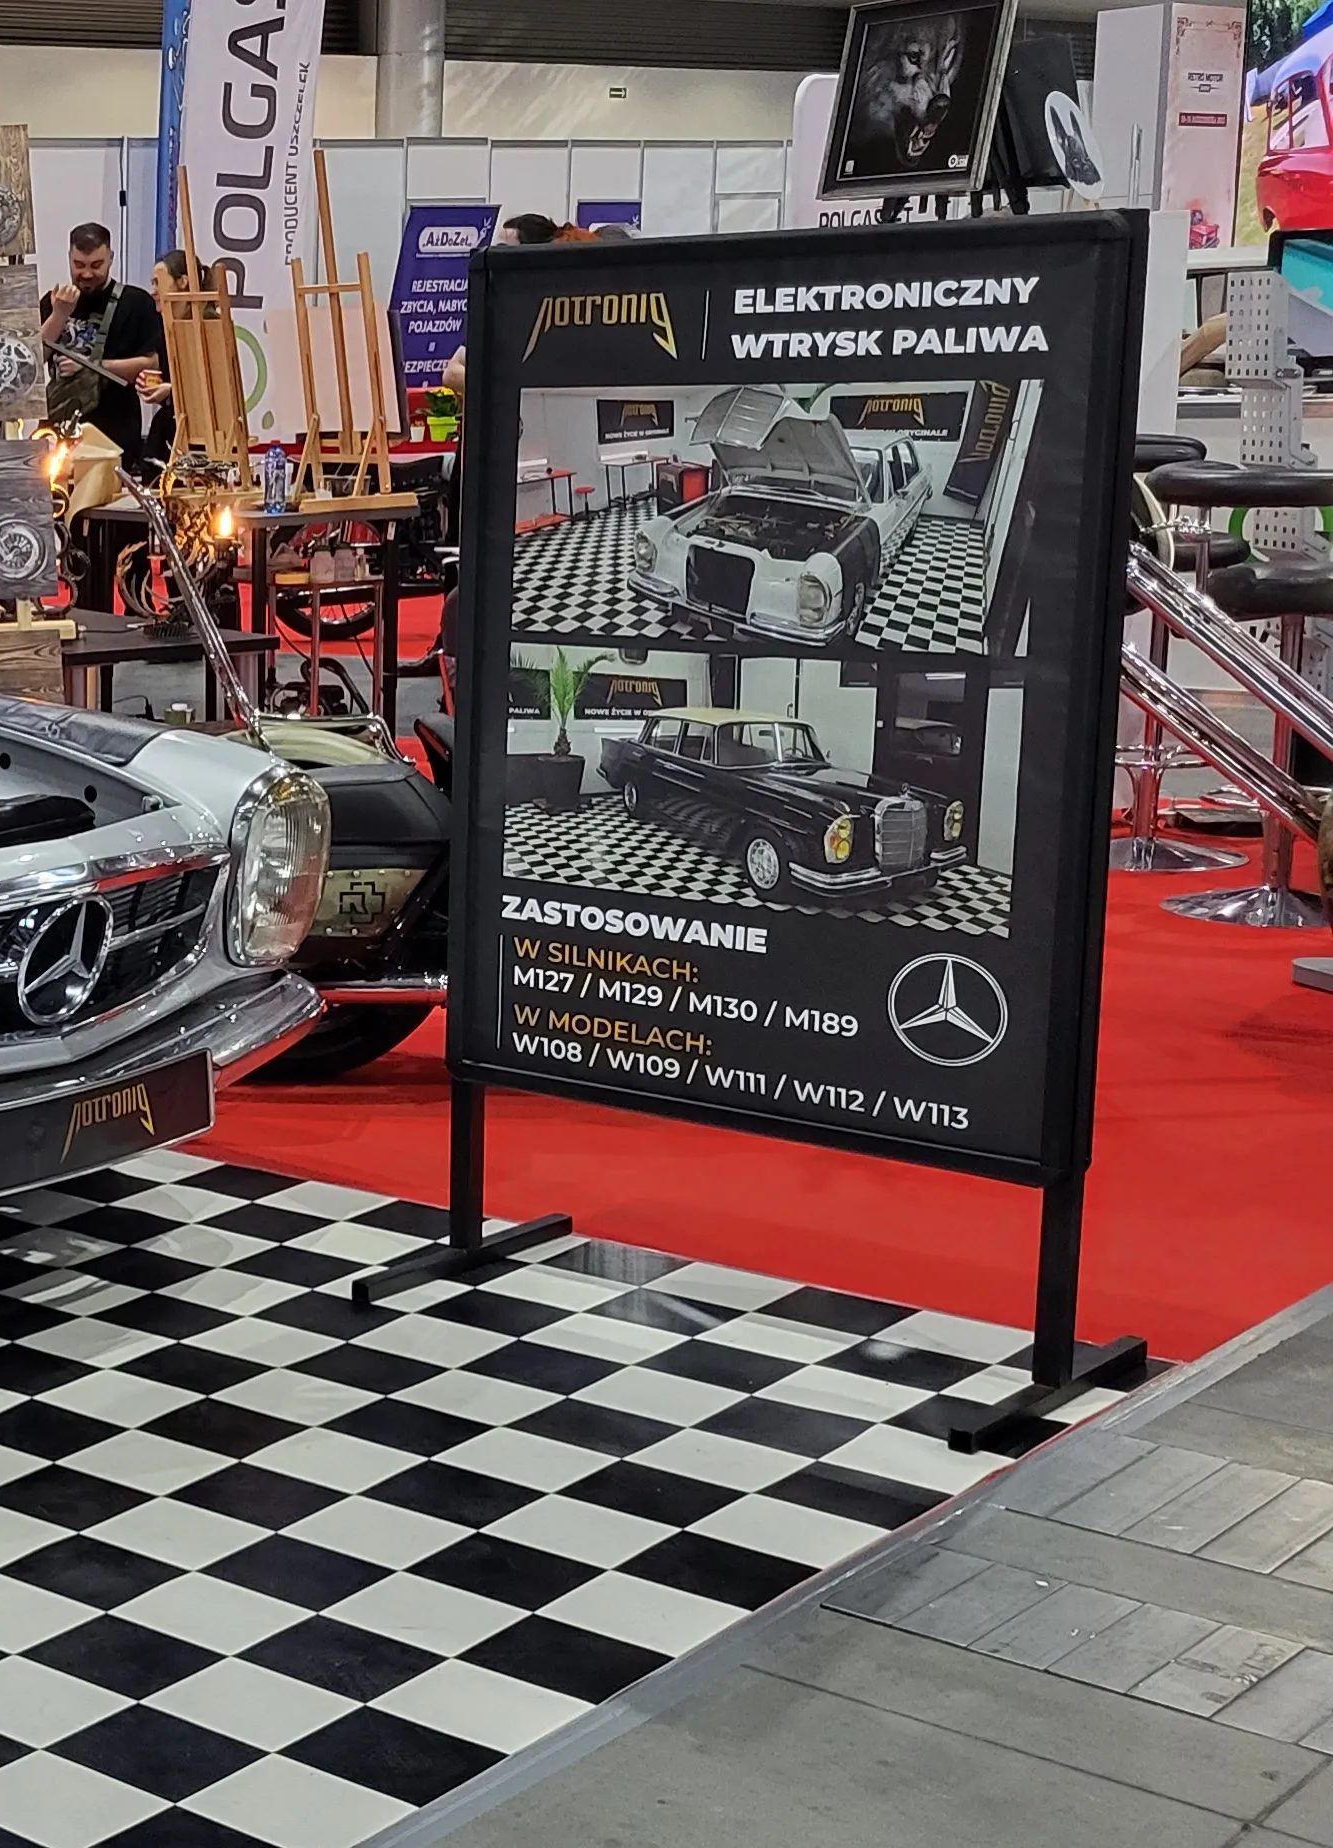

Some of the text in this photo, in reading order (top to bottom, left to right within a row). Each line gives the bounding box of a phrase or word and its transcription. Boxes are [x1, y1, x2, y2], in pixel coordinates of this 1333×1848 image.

[213, 0, 285, 309] POLGA
[400, 301, 436, 315] ZBYCIA,
[733, 276, 1039, 315] ELEKTRONICZNY
[408, 319, 462, 334] POJAZDÓW
[731, 326, 1048, 360] WTRYSK PALIWA
[509, 707, 540, 715] PALIWA
[611, 706, 632, 716] ŻYCIE
[502, 895, 767, 953] ZASTOSOWANIE
[514, 936, 699, 984] W SILNIKACH:
[514, 966, 858, 1037] M127 / M129 / M130 / M189
[514, 1004, 713, 1056] W MODELACH:
[512, 1032, 969, 1130] W108 / W109 / W111 / W112 / W113
